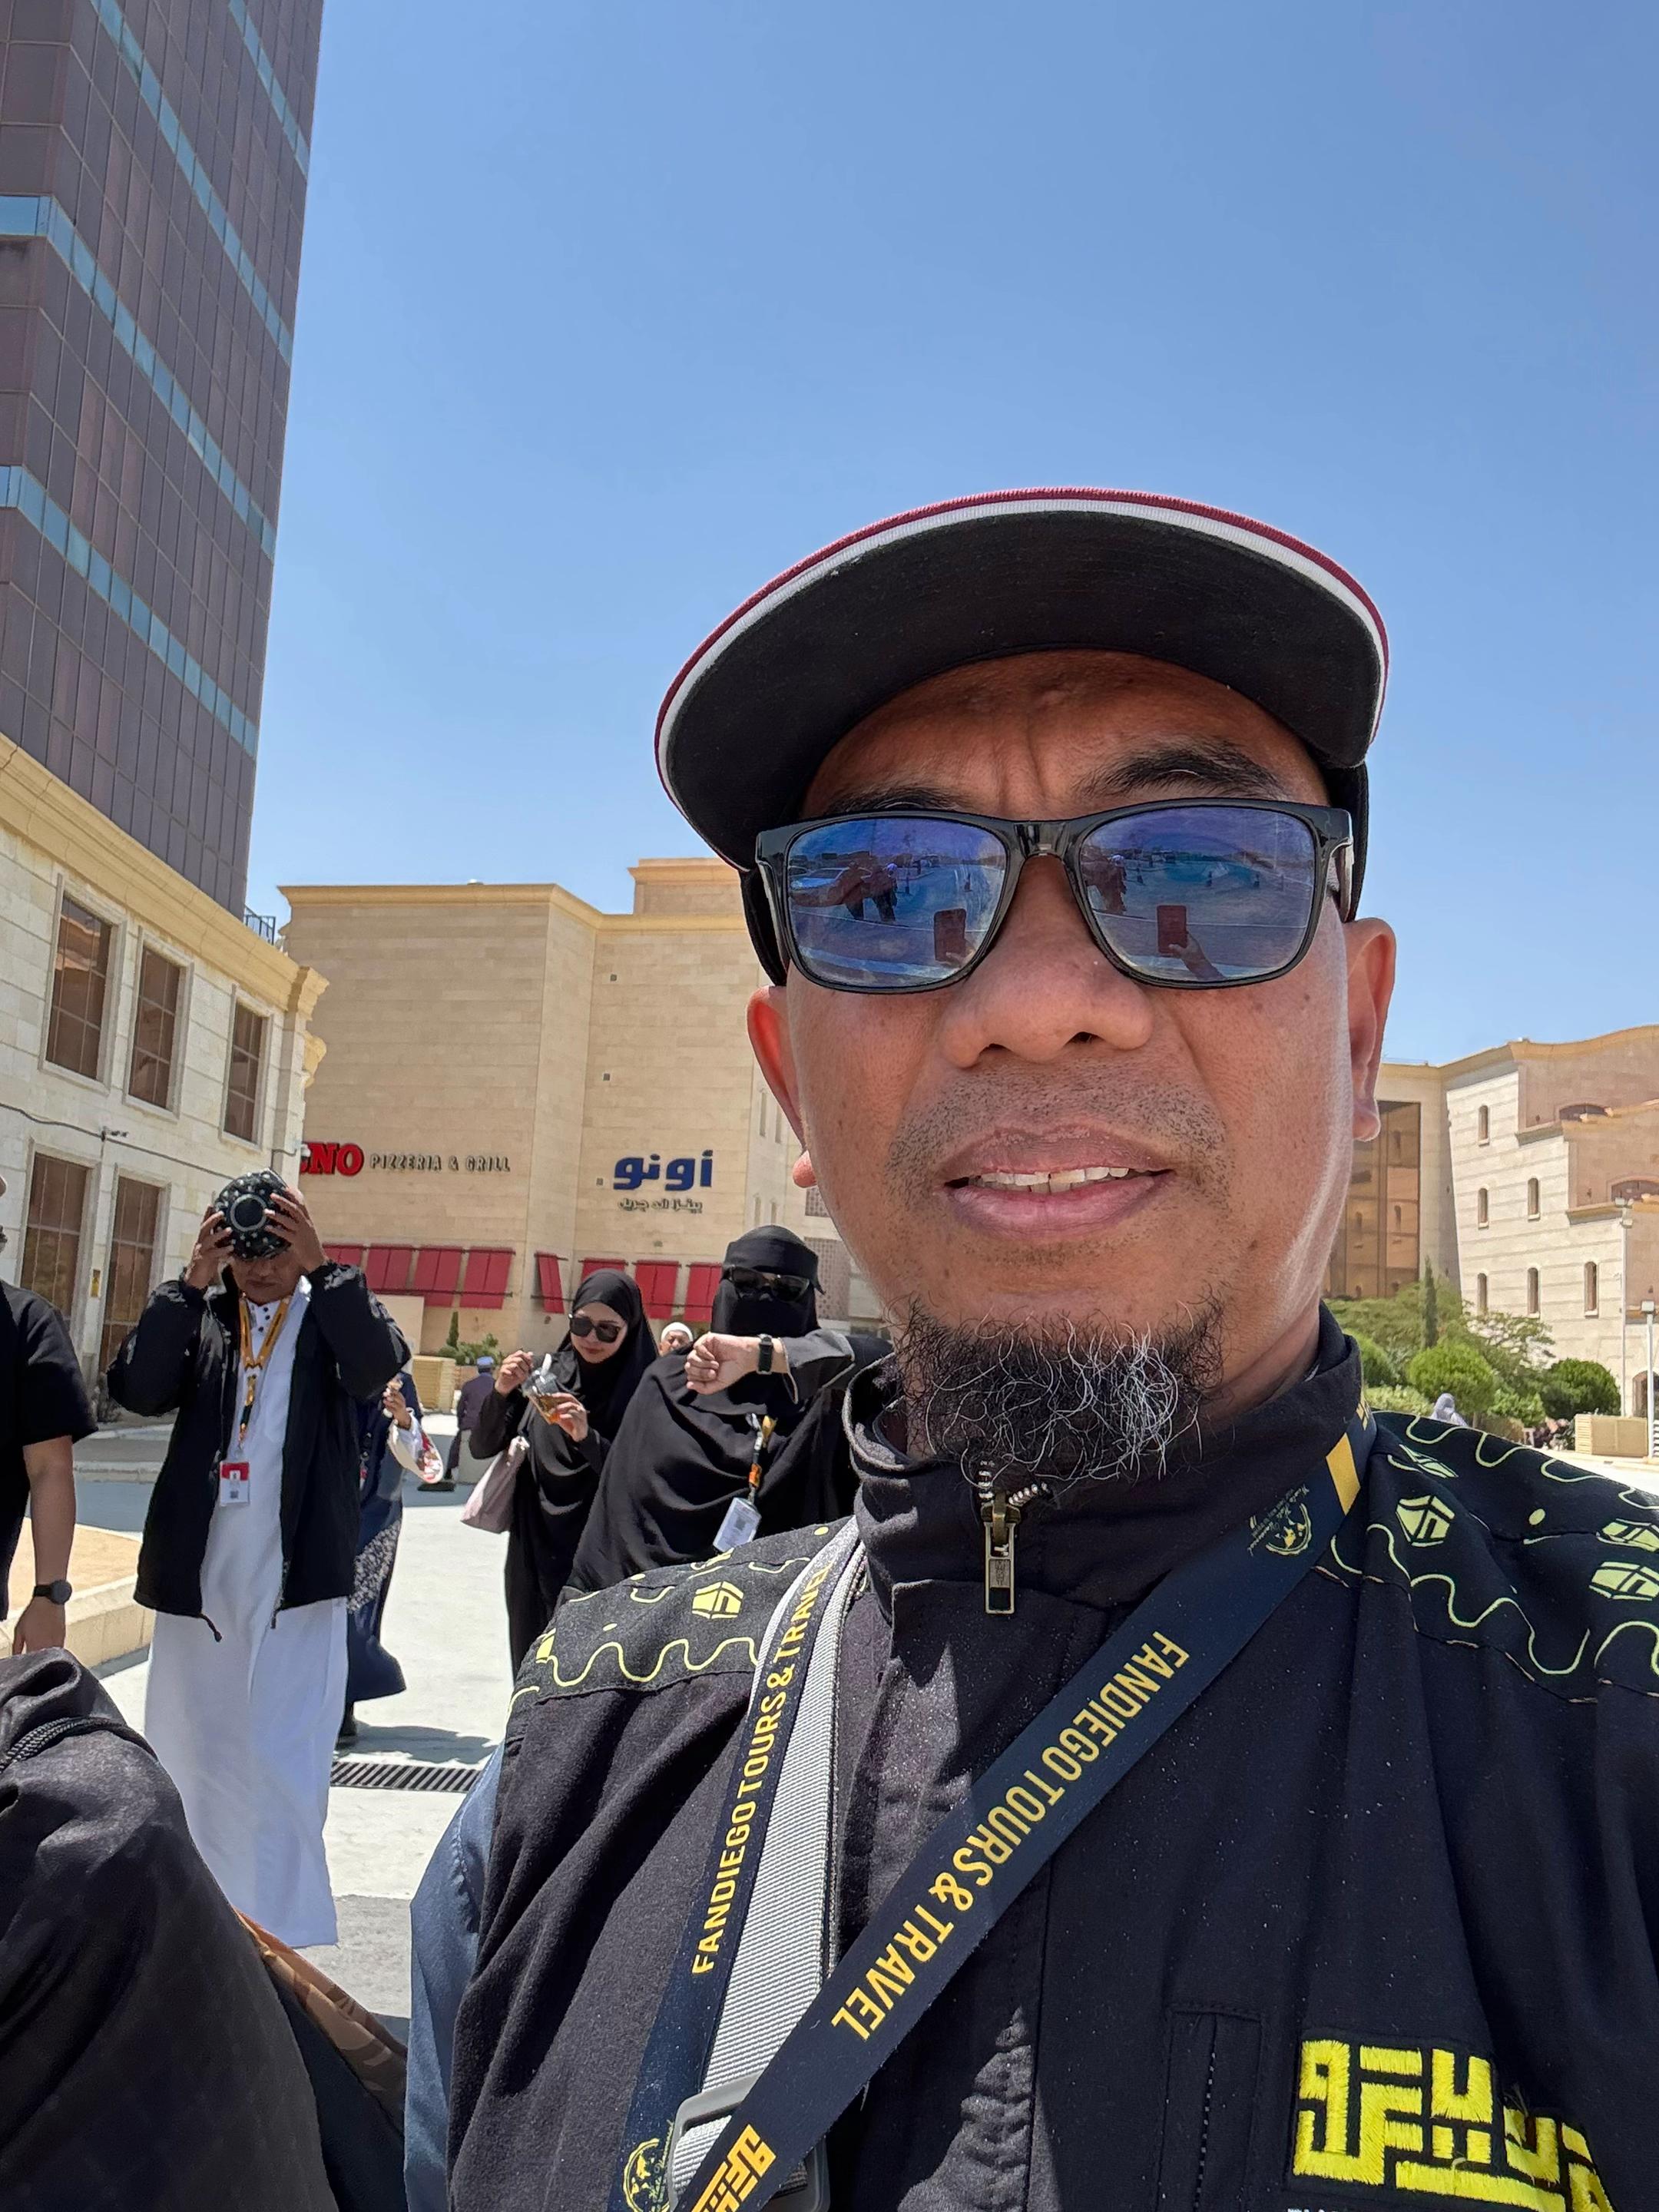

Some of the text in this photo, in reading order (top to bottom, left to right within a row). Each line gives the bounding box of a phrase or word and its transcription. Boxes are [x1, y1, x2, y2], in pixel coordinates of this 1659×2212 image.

[300, 1142, 511, 1176] NO PIZZERIA & GRILL
[613, 1149, 714, 1191] أونو
[692, 1560, 835, 1975] FANDIEGO TOURS & TRAVEL
[831, 1631, 1190, 2041] FANDIEGO TOURS & TRAVEL
